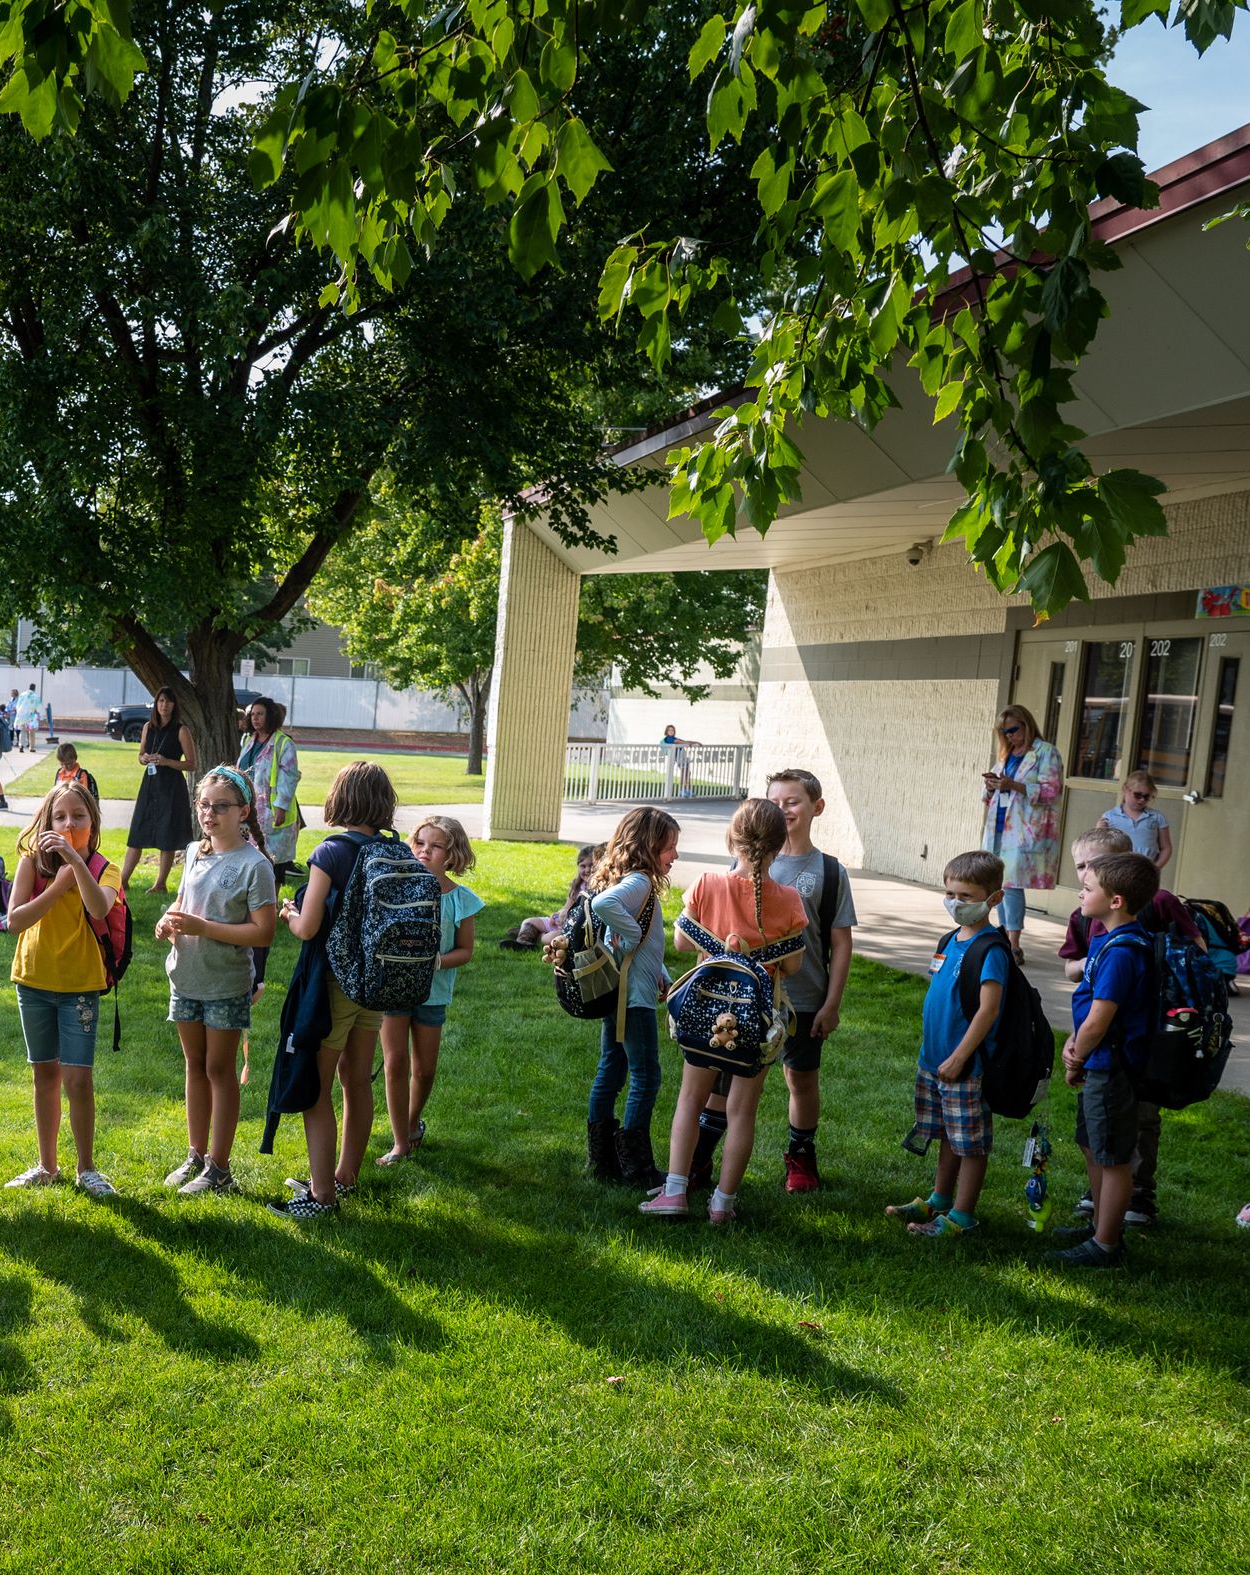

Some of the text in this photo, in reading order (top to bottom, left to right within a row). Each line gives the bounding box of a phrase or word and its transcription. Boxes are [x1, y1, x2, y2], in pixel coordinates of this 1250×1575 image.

[1065, 641, 1079, 653] 201
[1209, 633, 1228, 647] 202
[1150, 640, 1171, 657] 202
